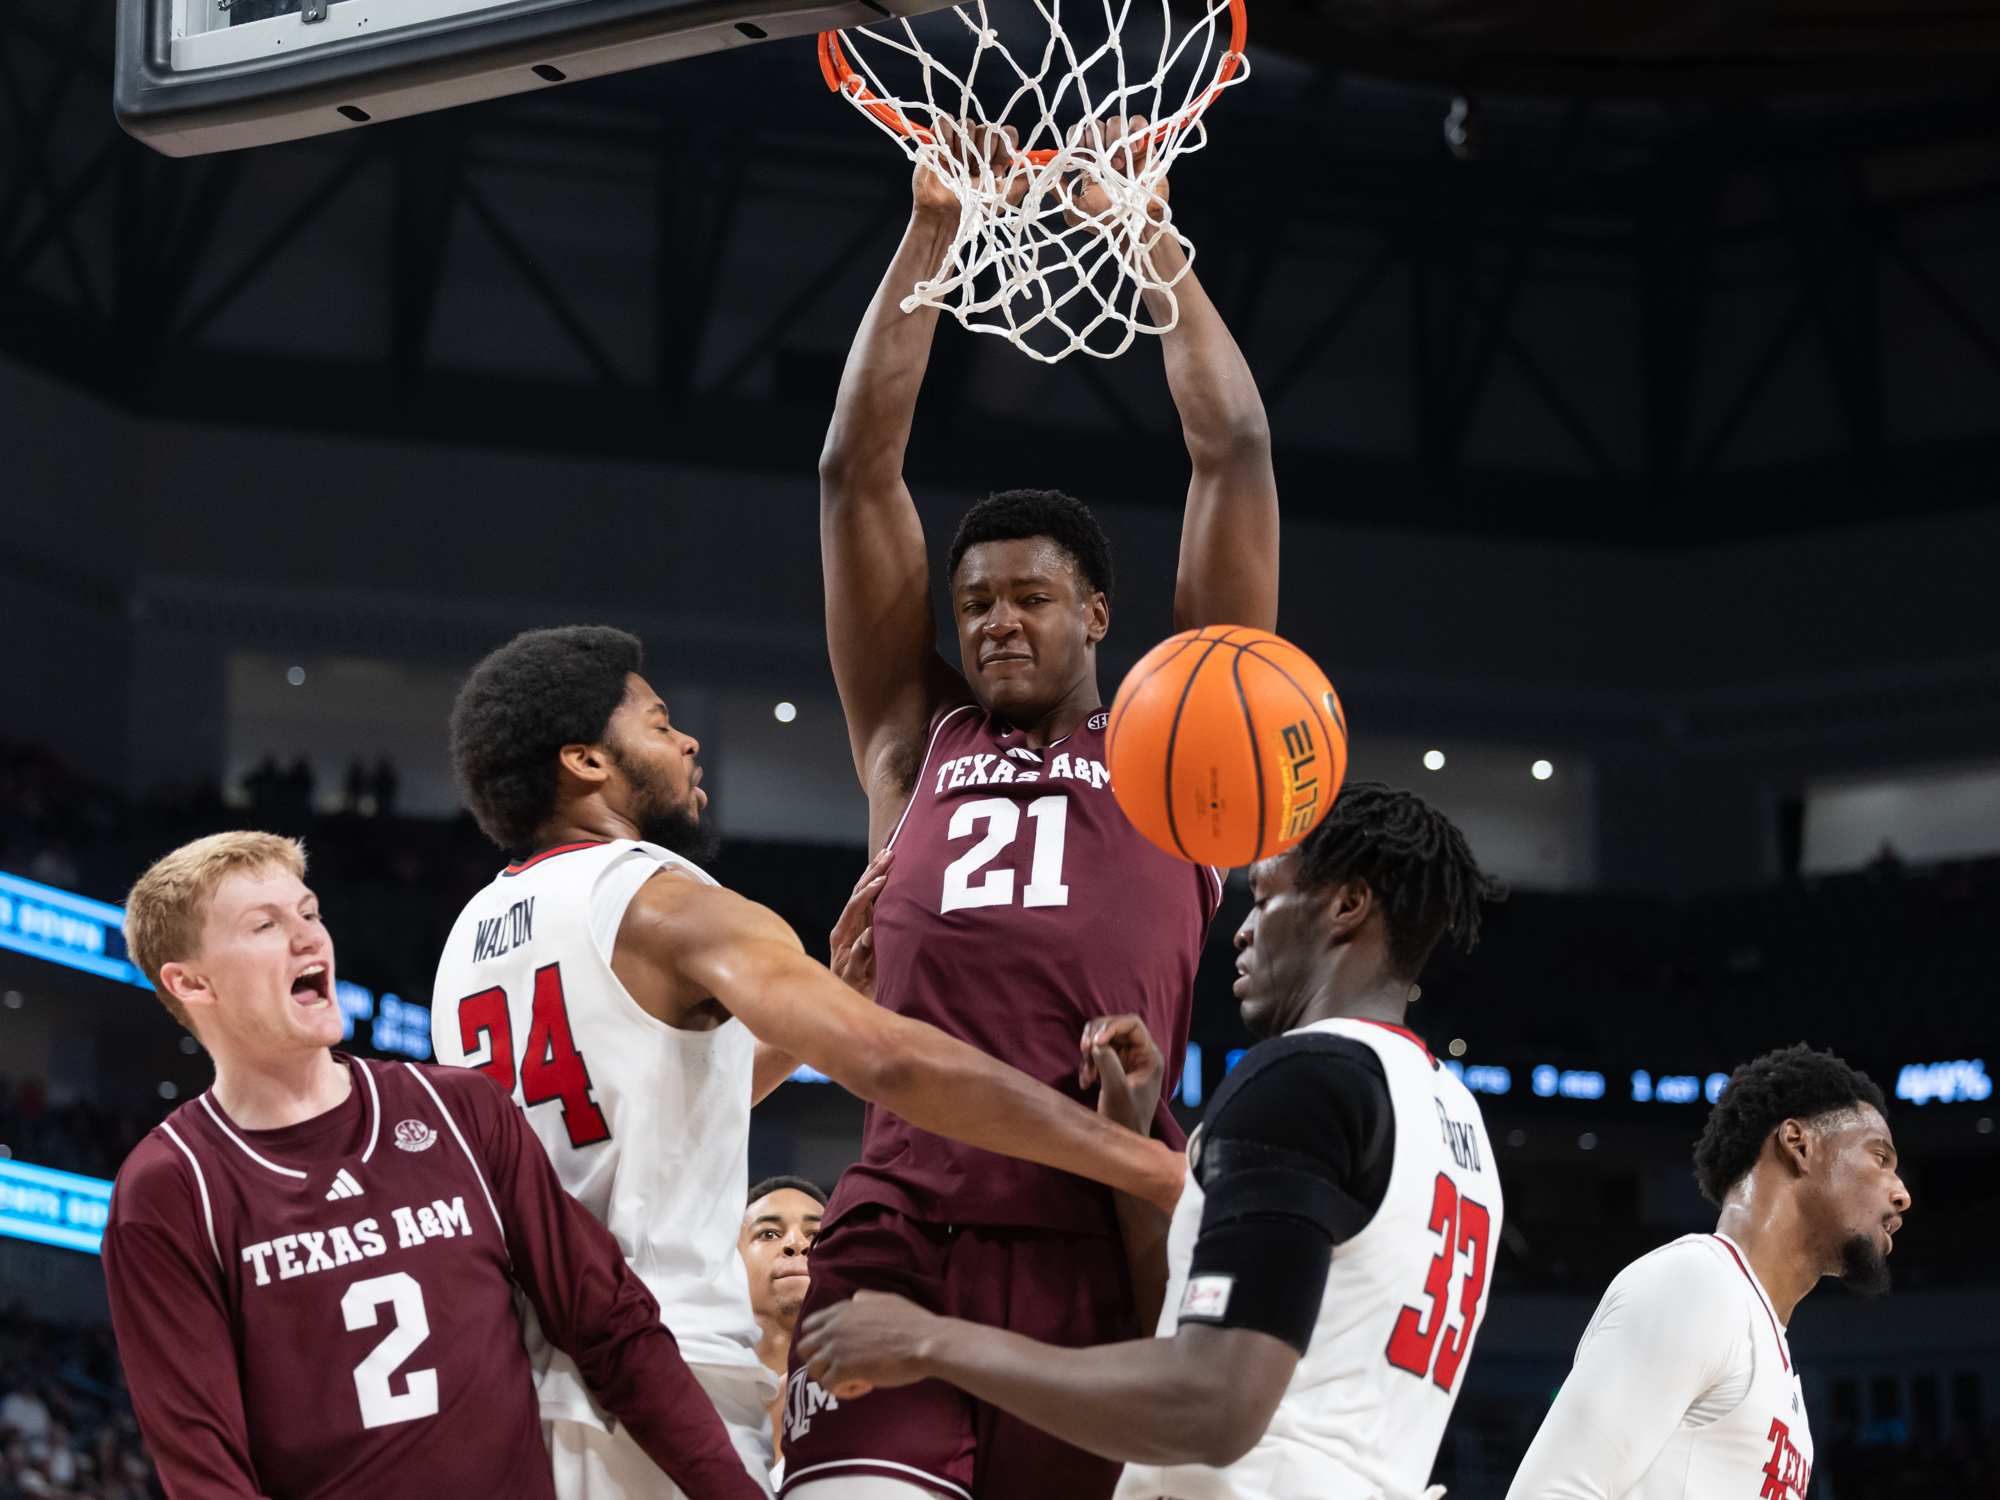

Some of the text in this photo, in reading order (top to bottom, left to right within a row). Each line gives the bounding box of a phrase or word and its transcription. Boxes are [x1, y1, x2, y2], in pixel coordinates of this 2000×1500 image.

[935, 754, 1041, 794] TEXAS
[1281, 719, 1318, 839] ELITE
[941, 795, 1069, 915] 21
[458, 961, 612, 1148] 24
[396, 1120, 428, 1143] SEC
[242, 1196, 472, 1286] TEXAS A&M
[1385, 1171, 1490, 1393] 33
[340, 1271, 439, 1429] 2
